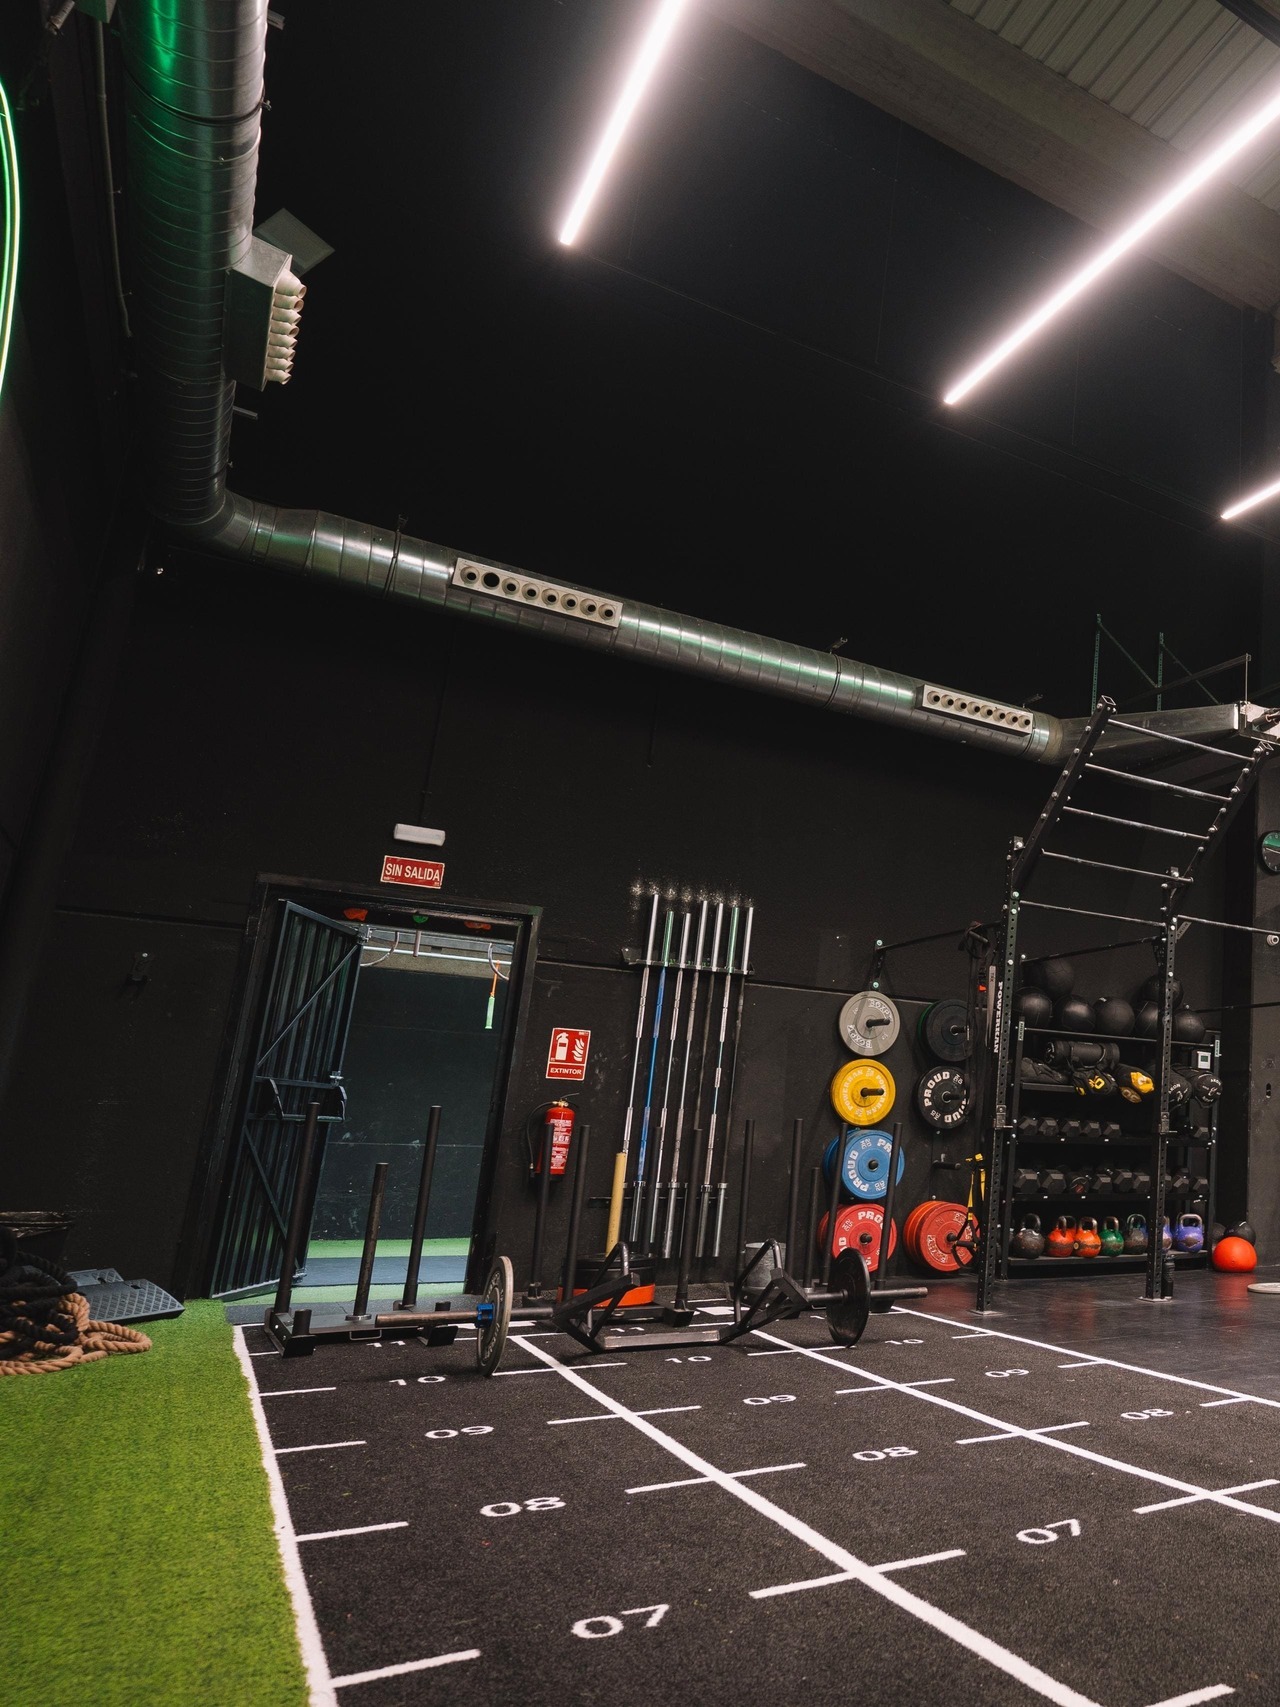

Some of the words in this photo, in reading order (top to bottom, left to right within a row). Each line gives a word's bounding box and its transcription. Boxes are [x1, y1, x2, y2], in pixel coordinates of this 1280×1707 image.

[385, 863, 403, 877] SIN
[404, 865, 440, 881] SALIDA
[550, 1067, 583, 1075] EXTINTOR
[924, 1071, 950, 1107] PROUD
[847, 1150, 869, 1192] PROUD
[665, 1355, 712, 1364] 10
[389, 1375, 446, 1386] 10
[985, 1368, 1030, 1379] 09
[742, 1394, 797, 1406] 09
[1120, 1408, 1174, 1421] 08
[424, 1425, 495, 1440] 09
[853, 1446, 919, 1462] 08
[479, 1496, 567, 1518] 08
[1015, 1518, 1081, 1545] 07
[570, 1603, 670, 1639] 07
